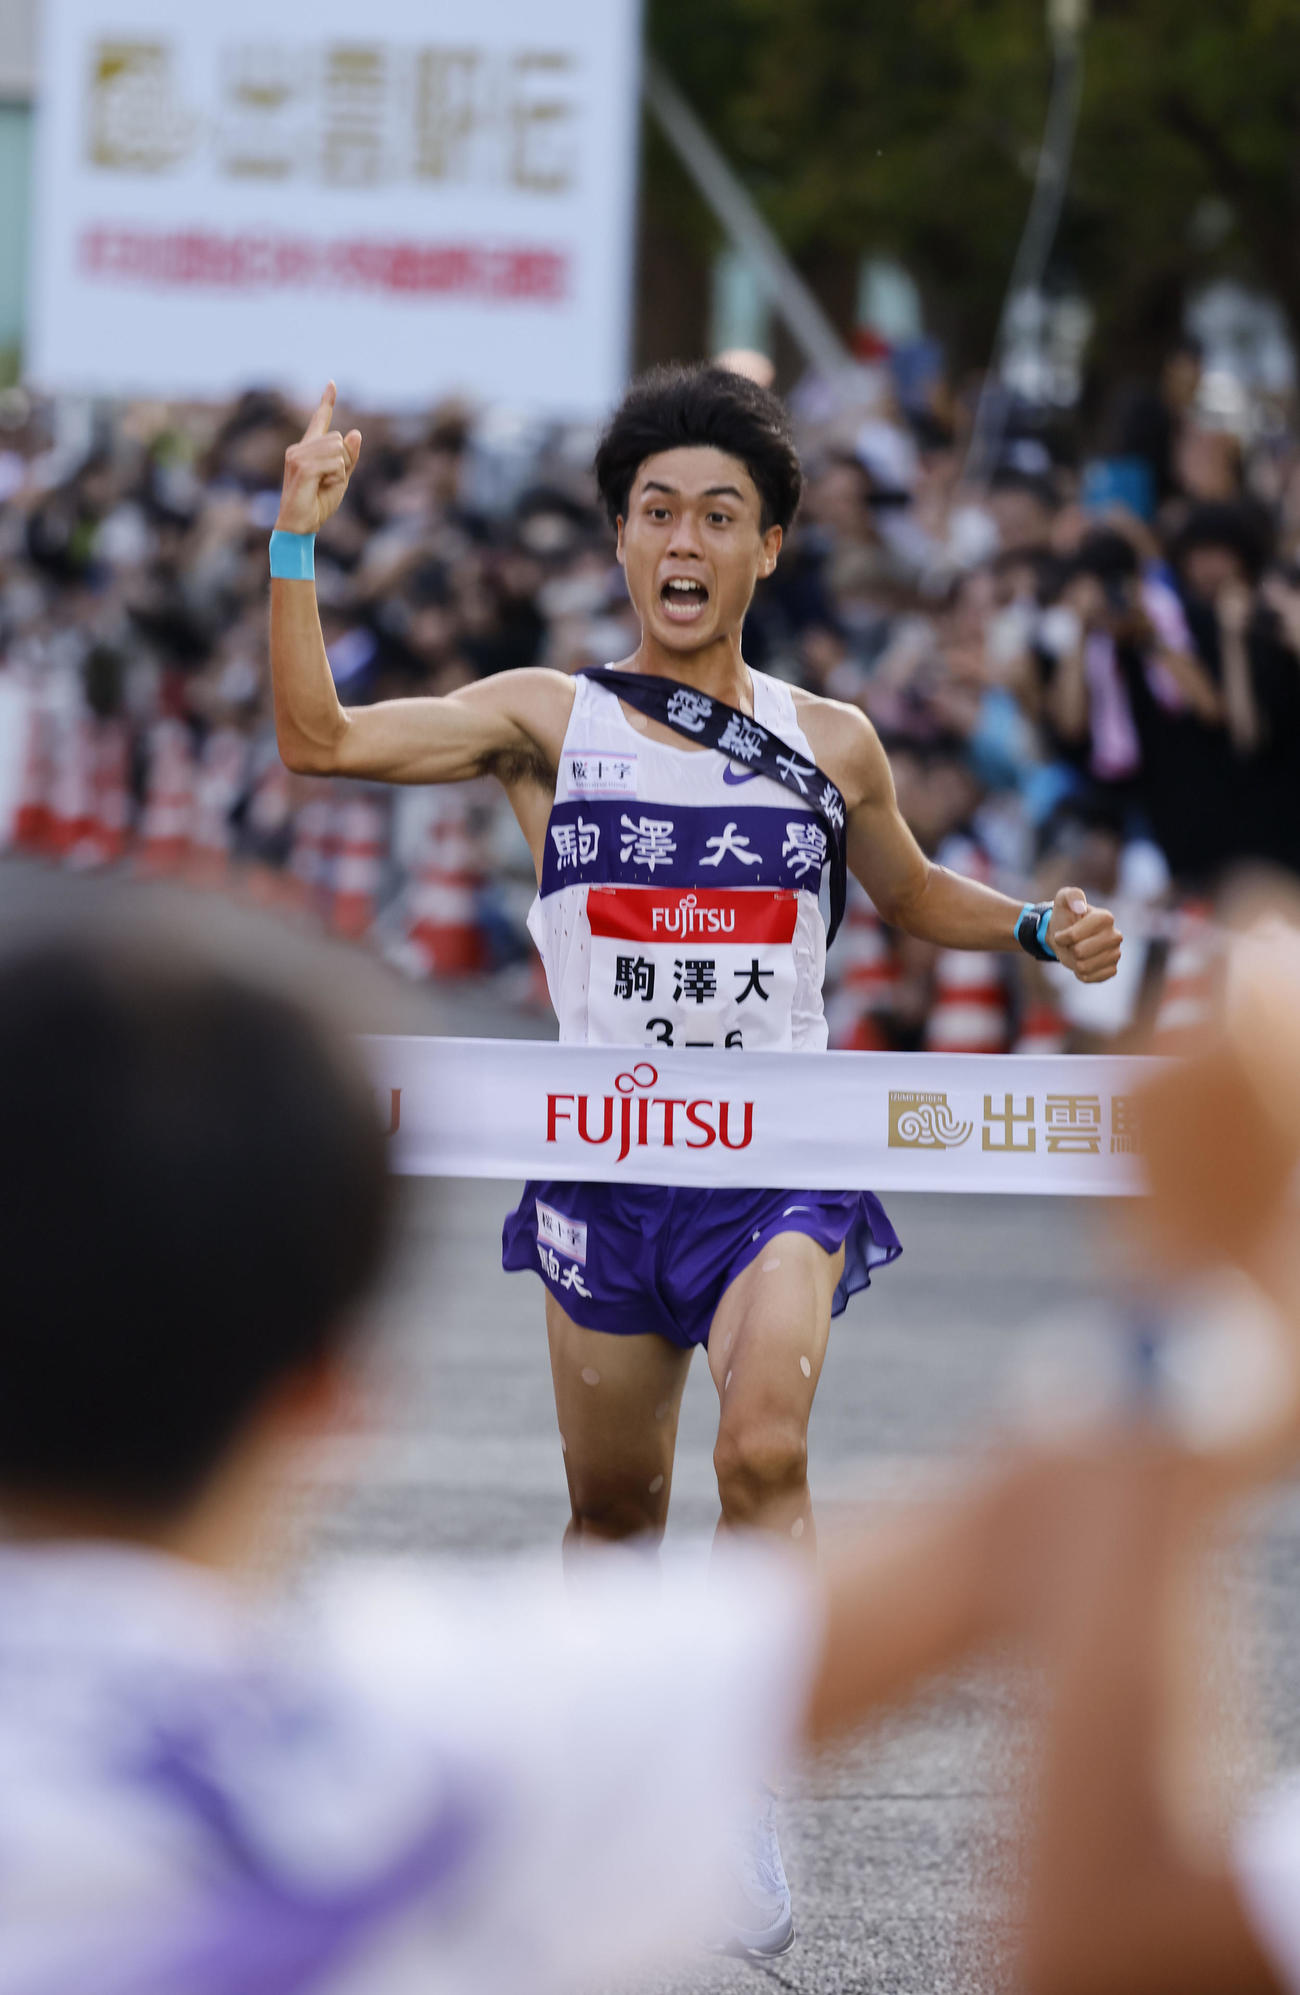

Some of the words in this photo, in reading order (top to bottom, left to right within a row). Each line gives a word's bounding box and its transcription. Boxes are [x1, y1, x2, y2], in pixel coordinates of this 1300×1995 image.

[570, 760, 631, 779] 桜十字
[551, 815, 827, 879] 駒澤大學
[652, 894, 736, 938] FUJITSU
[613, 955, 775, 1005] 駒澤大
[545, 1062, 755, 1163] FUJITSU
